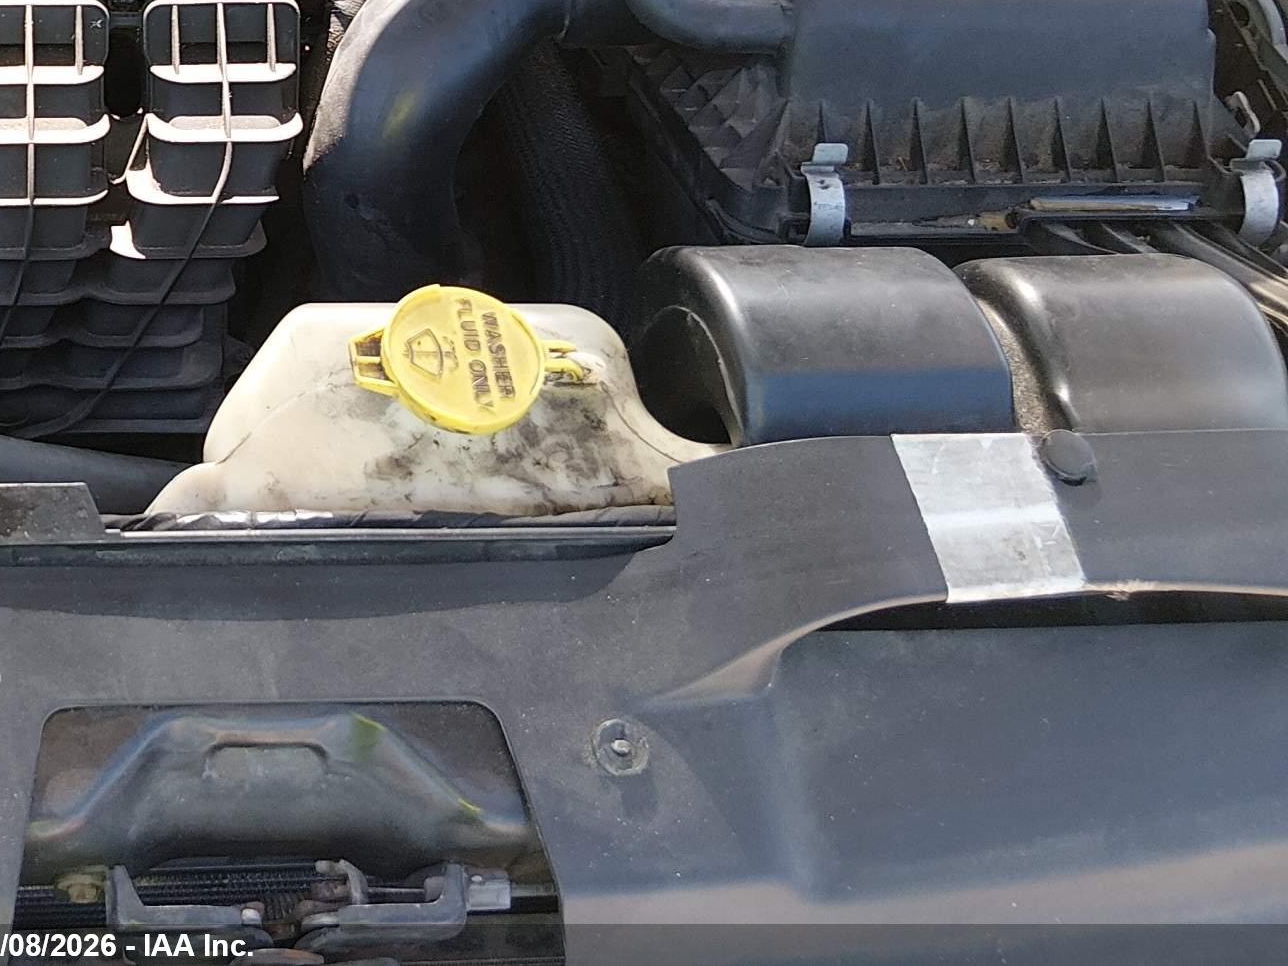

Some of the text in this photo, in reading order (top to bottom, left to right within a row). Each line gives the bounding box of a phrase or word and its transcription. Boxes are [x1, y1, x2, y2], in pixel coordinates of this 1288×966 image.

[454, 297, 497, 416] FLUID ONLY
[481, 311, 516, 400] WASHER
